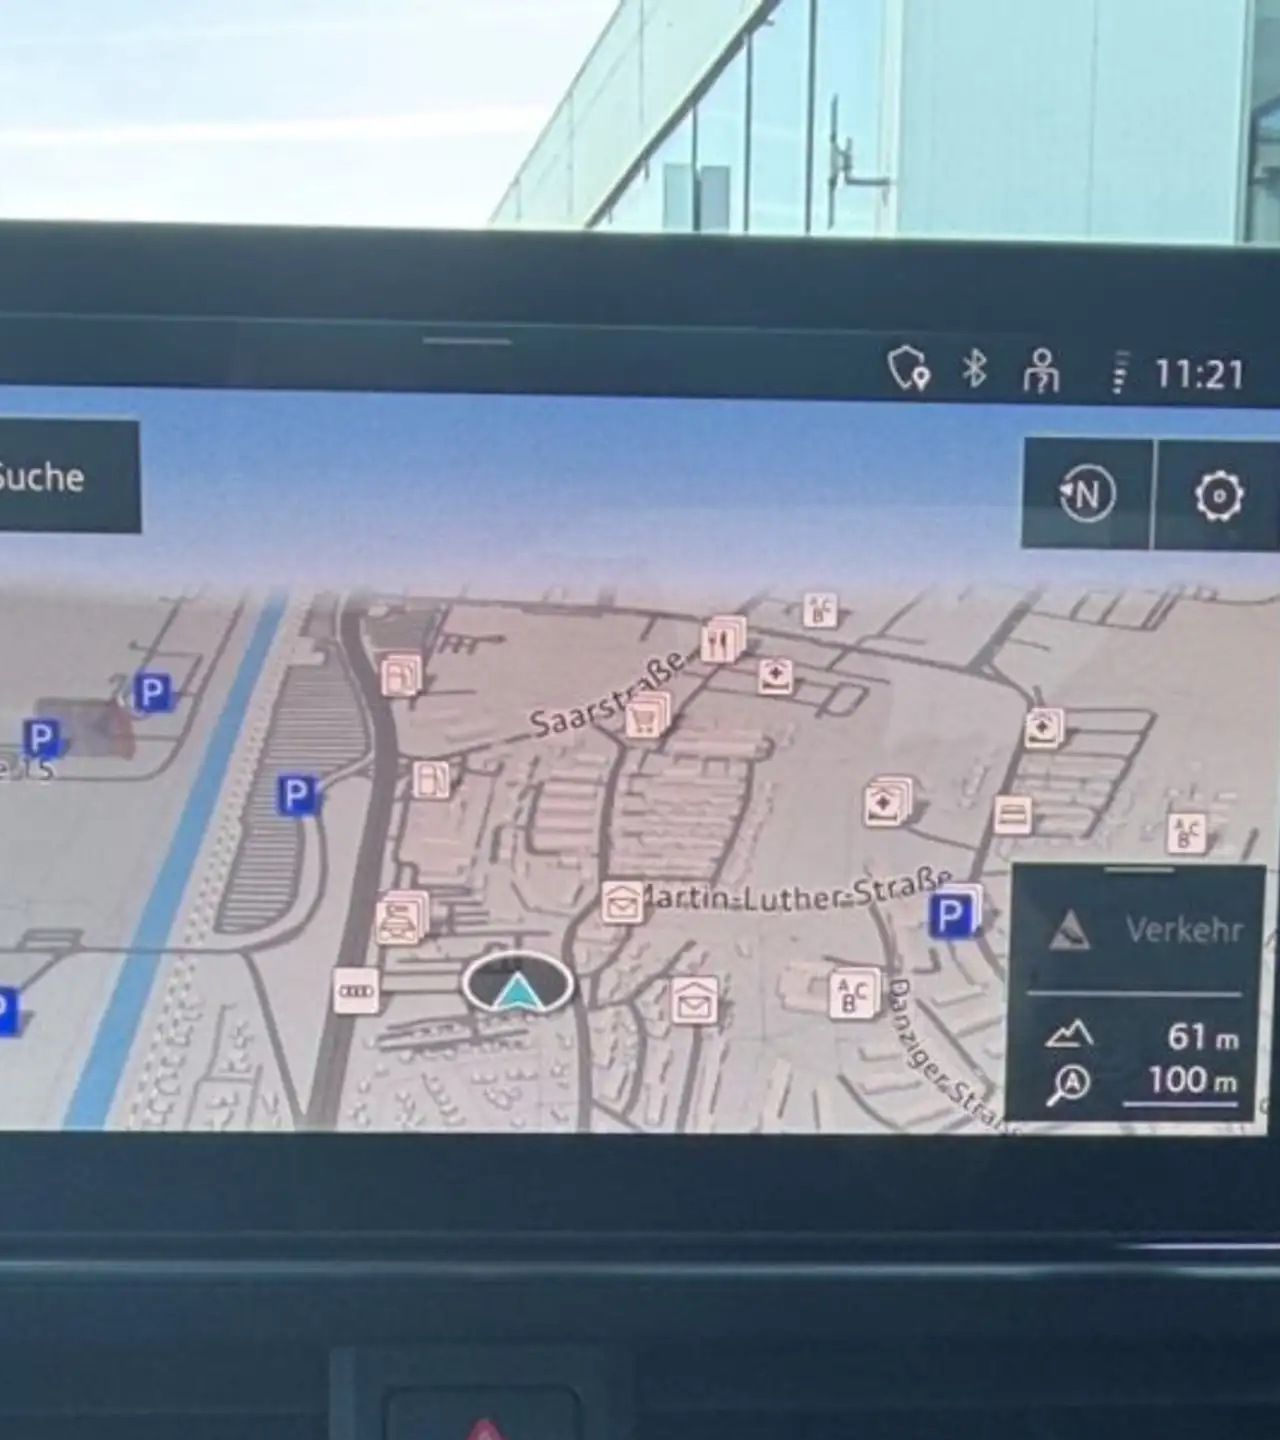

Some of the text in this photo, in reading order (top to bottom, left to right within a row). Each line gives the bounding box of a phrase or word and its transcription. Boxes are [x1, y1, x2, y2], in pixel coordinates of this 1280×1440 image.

[1155, 358, 1244, 389] 11:21
[1076, 480, 1100, 509] N
[529, 652, 685, 738] Saarstraße
[1126, 914, 1246, 944] Verkehr
[1168, 1023, 1239, 1051] 61 m
[1149, 1066, 1238, 1094] 100 m
